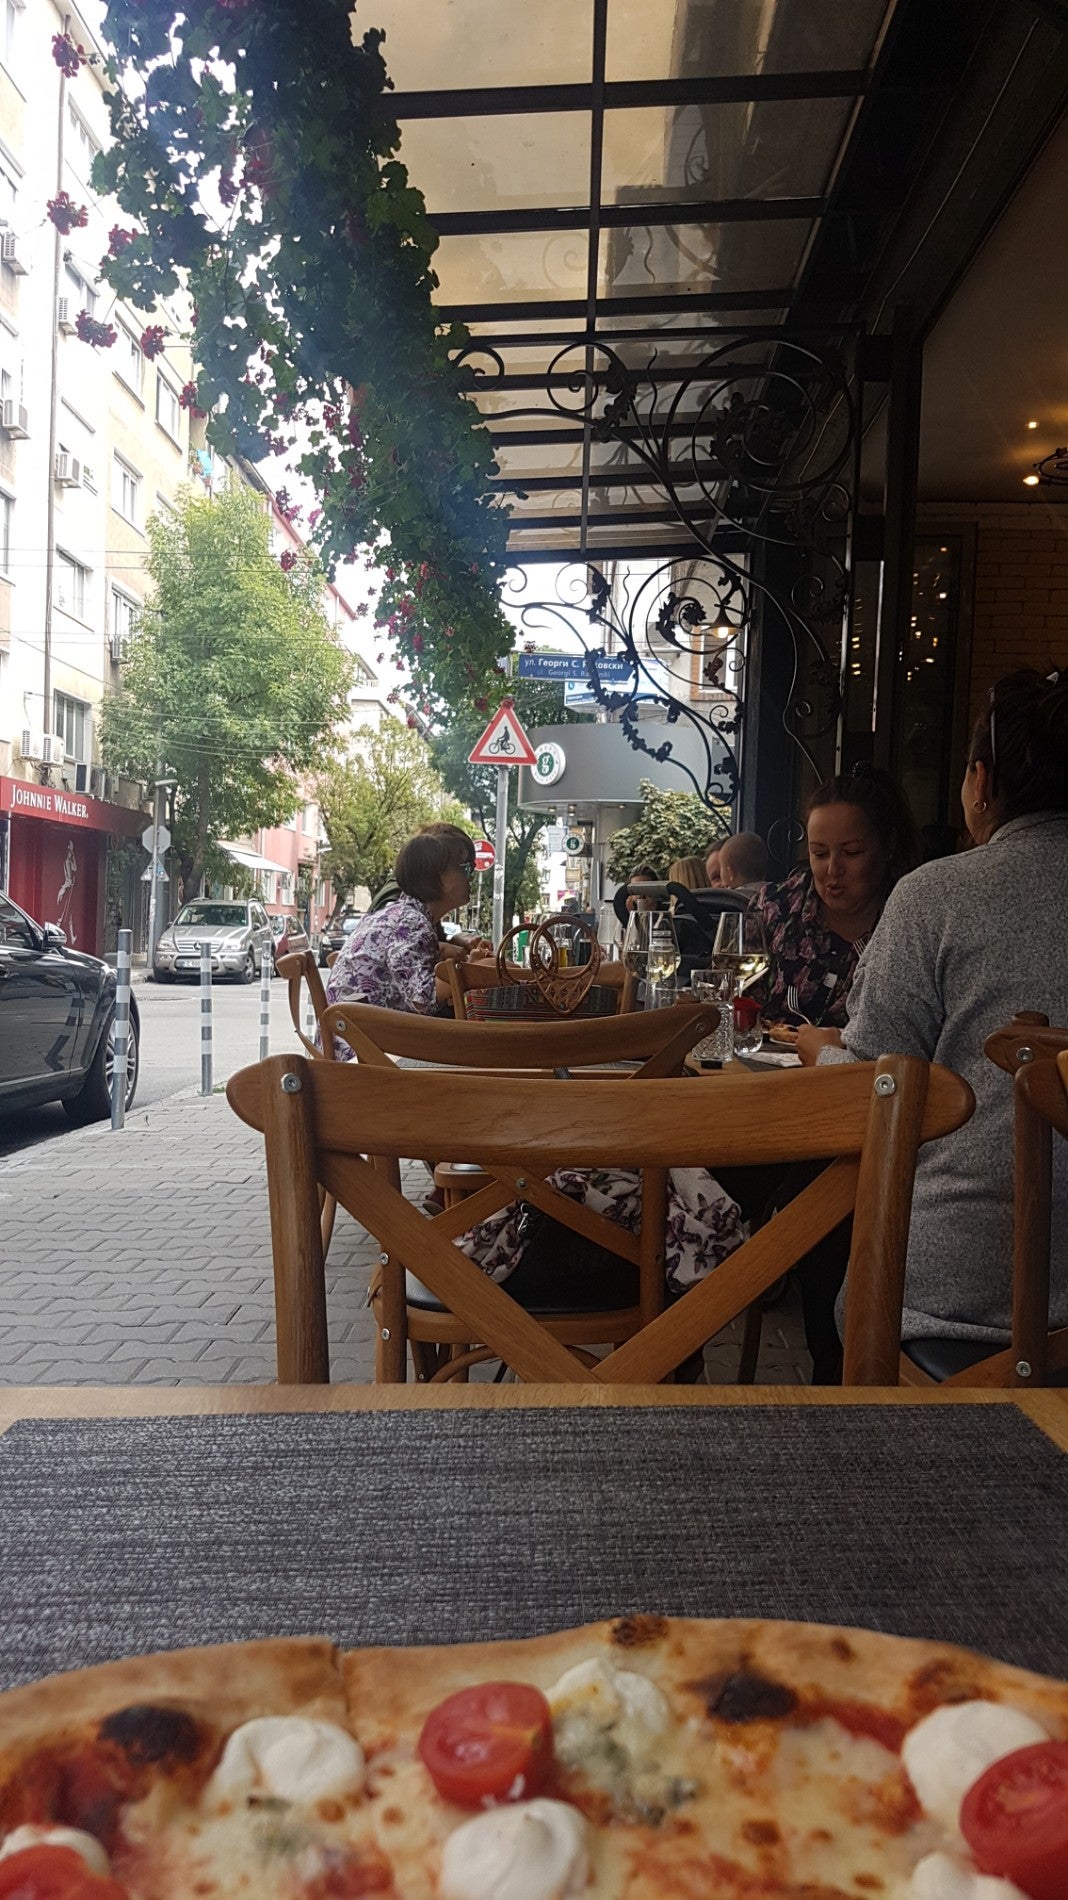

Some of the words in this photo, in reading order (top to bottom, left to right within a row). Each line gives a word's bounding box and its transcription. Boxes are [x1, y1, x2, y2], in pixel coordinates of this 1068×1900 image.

[524, 658, 536, 667] ул.
[538, 658, 569, 669] Георги
[571, 660, 580, 668] С.
[548, 669, 571, 678] Georgi
[10, 784, 52, 810] JOHNNIE
